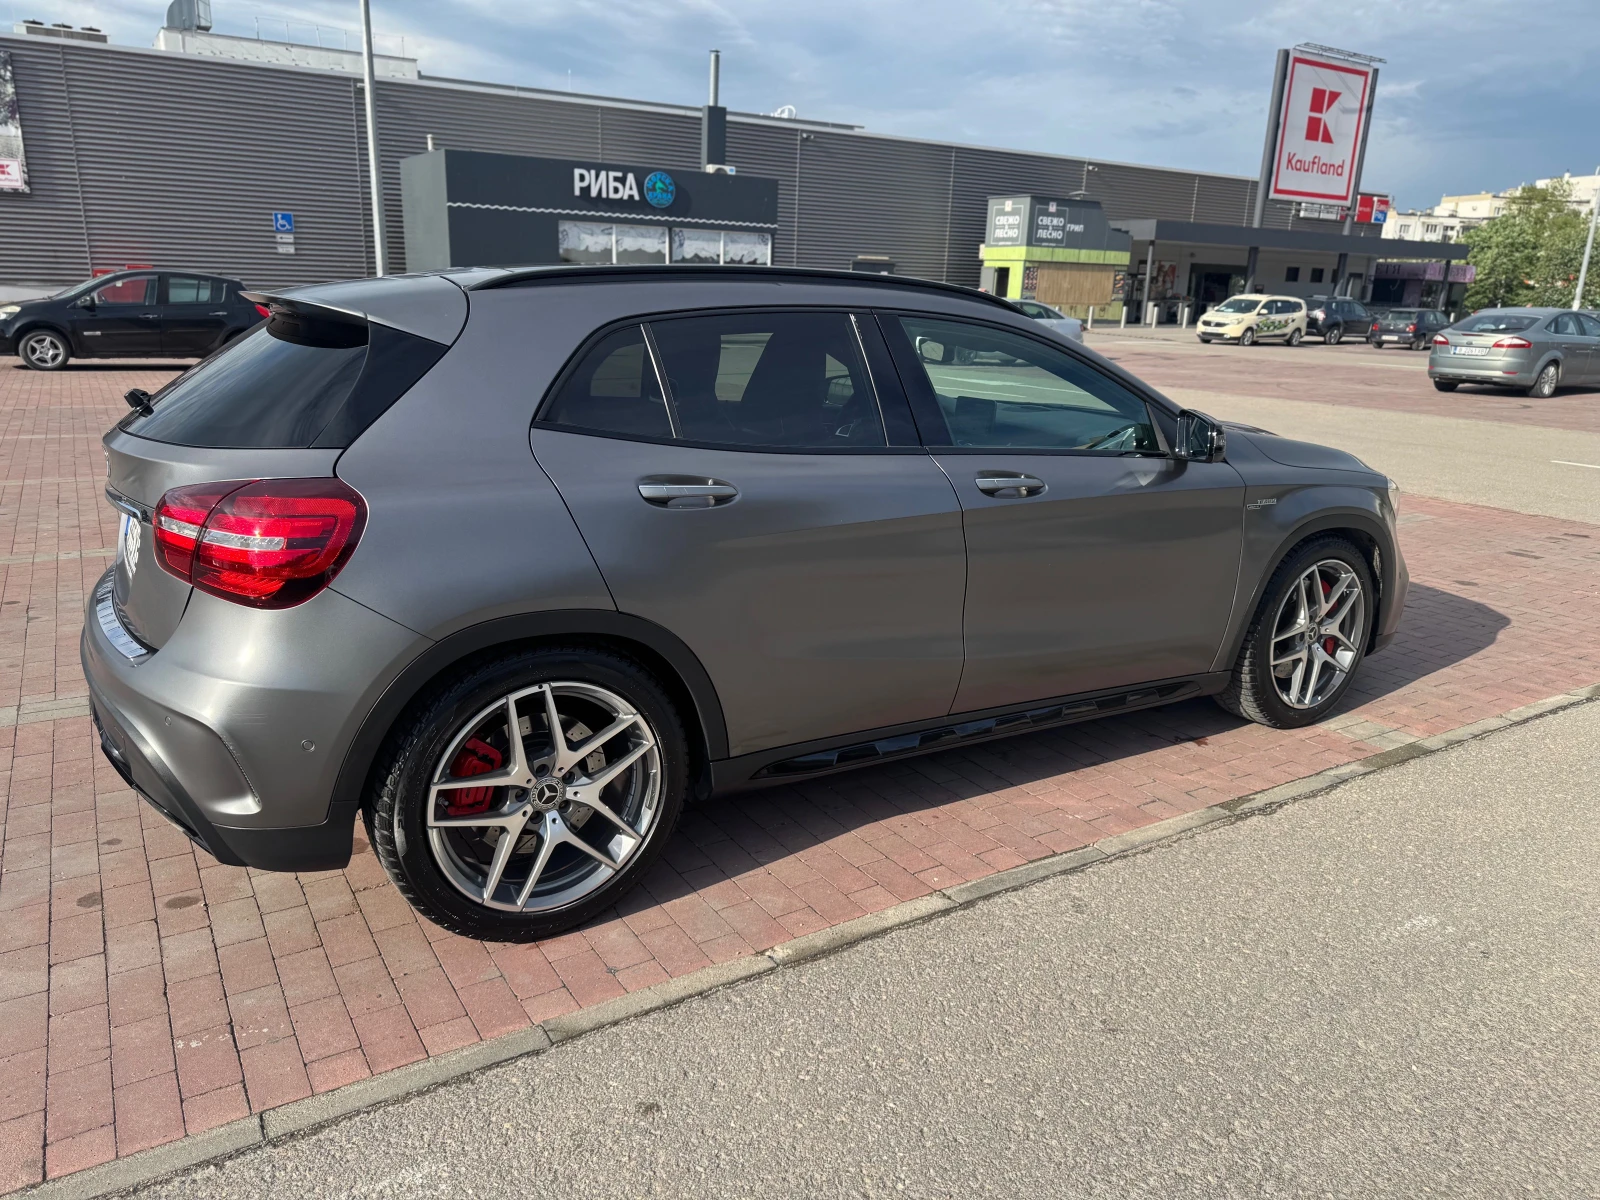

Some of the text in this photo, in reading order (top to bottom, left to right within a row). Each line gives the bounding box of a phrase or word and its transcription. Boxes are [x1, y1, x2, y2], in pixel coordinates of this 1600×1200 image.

[1286, 152, 1345, 177] Kaufland
[573, 168, 640, 201] РИБА
[995, 215, 1020, 225] СВЕЖО
[1037, 216, 1065, 227] СВЕЖО
[994, 228, 1019, 238] ЛЕСНО
[1036, 229, 1064, 240] ЛЕСНО
